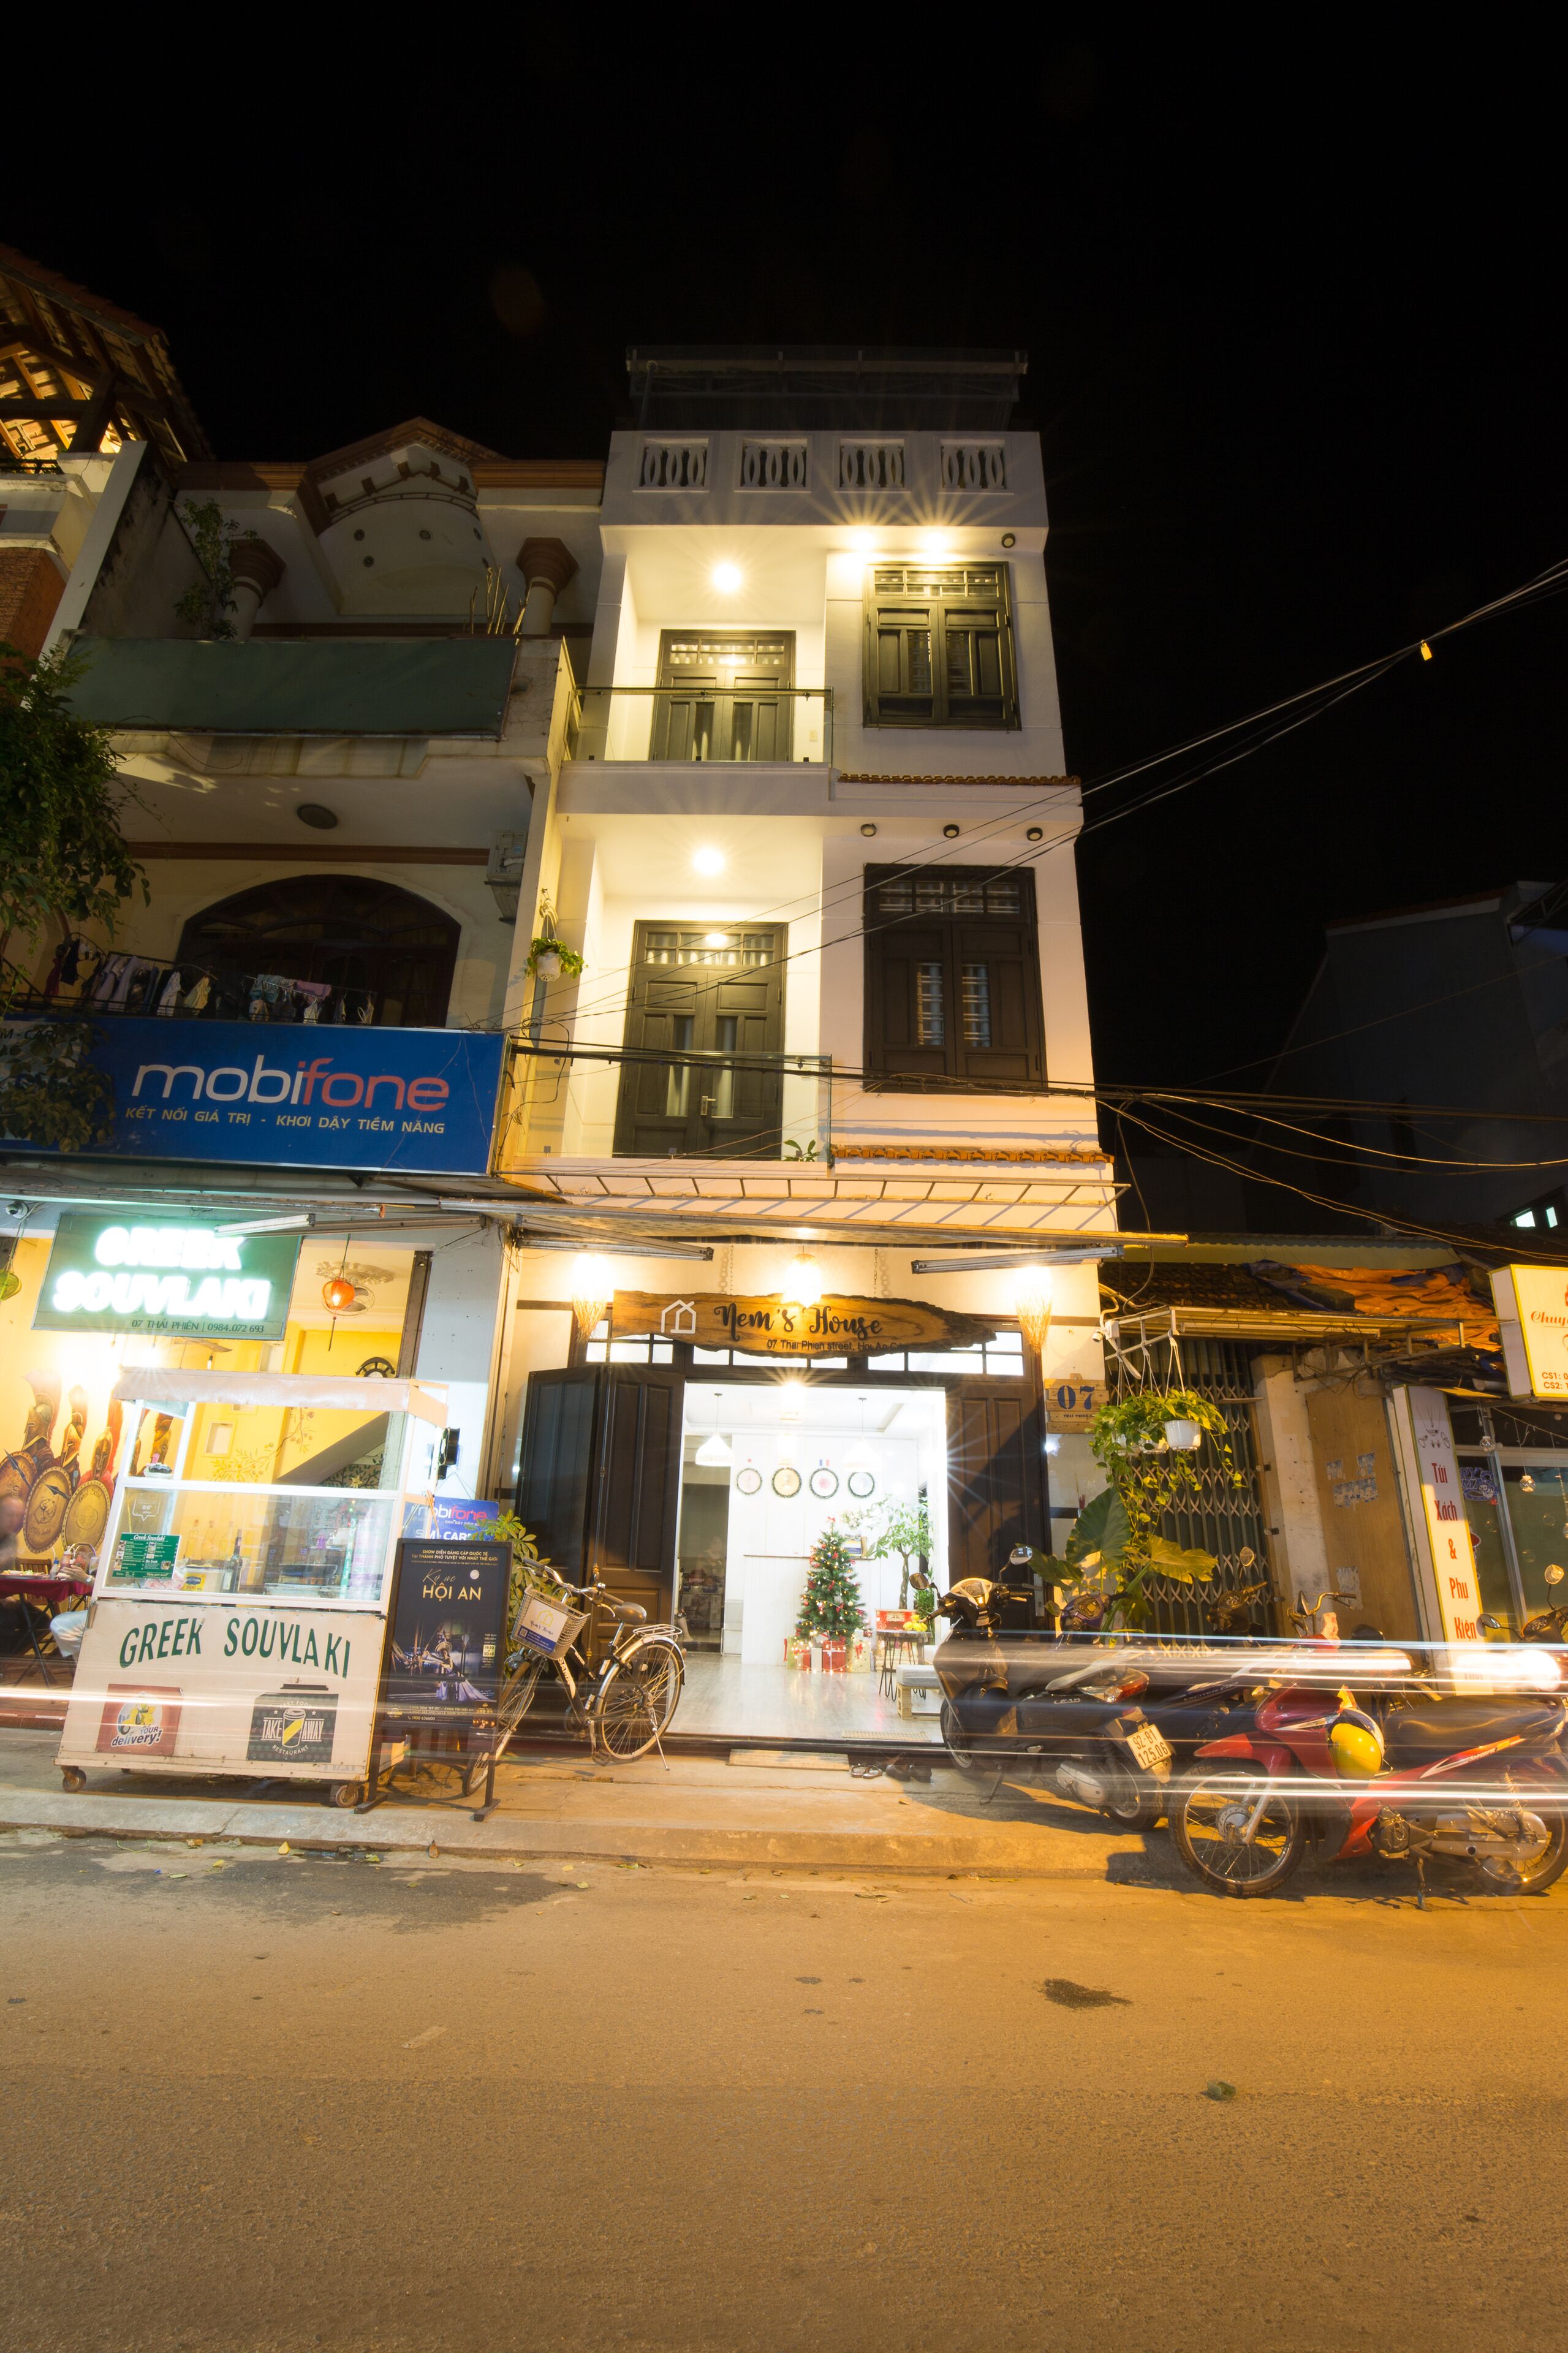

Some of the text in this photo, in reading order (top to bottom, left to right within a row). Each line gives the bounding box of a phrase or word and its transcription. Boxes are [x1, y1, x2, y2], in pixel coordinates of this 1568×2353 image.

[132, 1055, 449, 1112] mobifone
[125, 1104, 156, 1119] KẾT
[162, 1107, 188, 1121] NỐI
[194, 1109, 220, 1123] GIÁ
[228, 1112, 252, 1126] TRỊ
[276, 1115, 311, 1127] KHƠI
[318, 1115, 351, 1131] DẬY
[357, 1116, 395, 1132] TIỀM
[401, 1120, 445, 1134] NĂNG
[95, 1227, 246, 1270] GREEK
[53, 1271, 273, 1319] SOUVLAKI
[132, 1319, 265, 1333] 07 THÁI PHIÊN 0984.072 693
[802, 1305, 883, 1341] House
[1531, 1311, 1568, 1327] Chuy
[767, 1339, 778, 1349] 07
[827, 1340, 855, 1352] street,
[1057, 1385, 1095, 1410] 07
[1431, 1462, 1449, 1484] Túi
[1434, 1499, 1458, 1521] Xách
[1448, 1538, 1458, 1560] &
[422, 1582, 482, 1602] HỘI AN
[1449, 1577, 1469, 1601] Phụ
[1454, 1616, 1477, 1642] Kiện
[119, 1618, 206, 1669] GREEK
[224, 1618, 351, 1680] SOUVLAKI
[112, 1729, 162, 1746] delivery!
[262, 1719, 325, 1740] TAKE AWAY
[272, 1744, 309, 1756] RESTAURANT
[1138, 1741, 1168, 1766] 125.06
